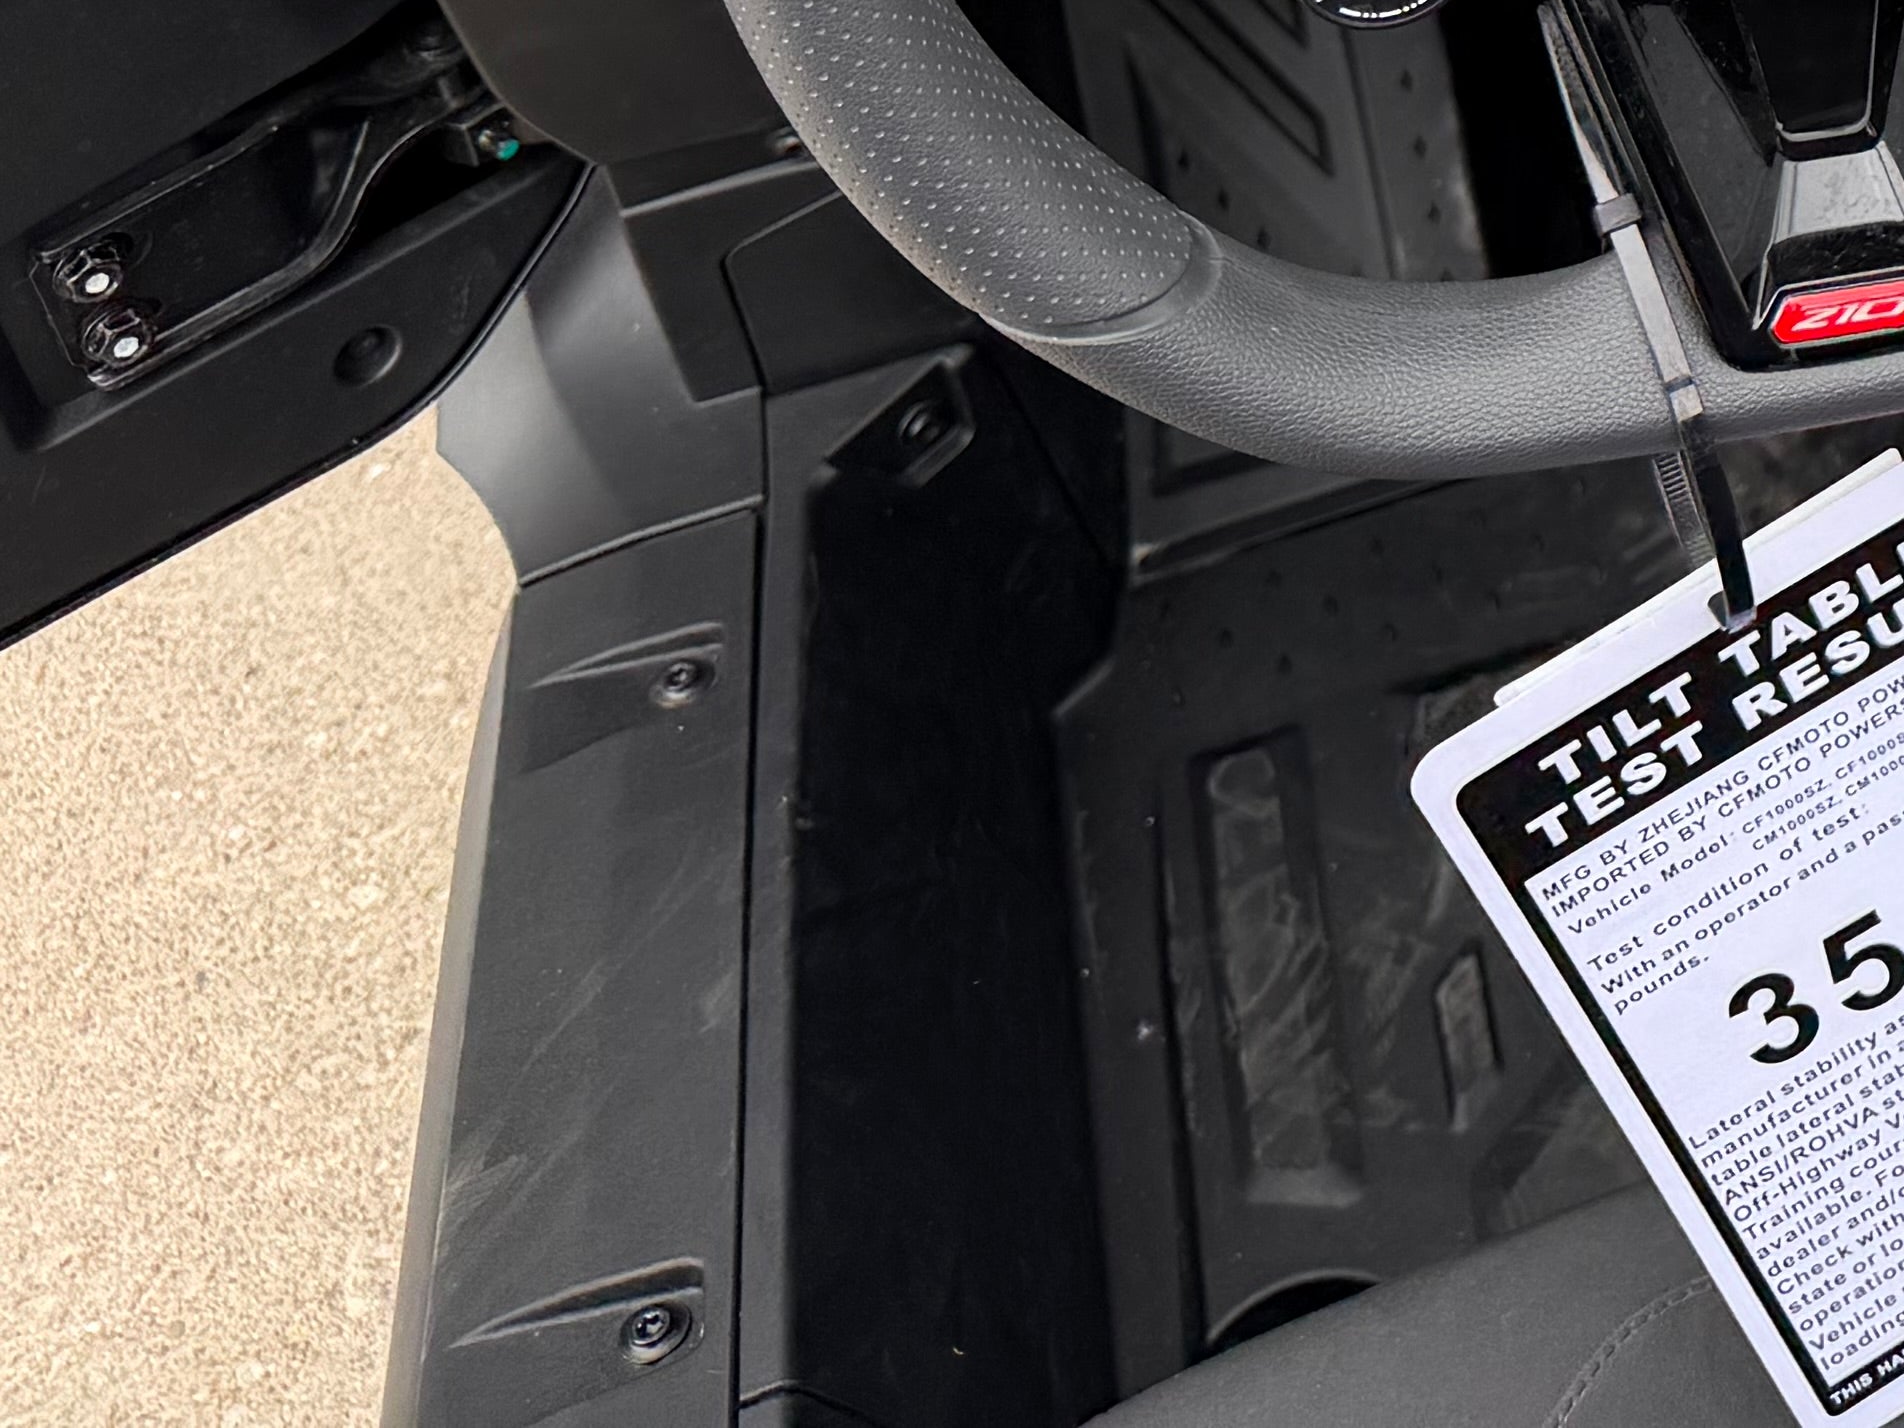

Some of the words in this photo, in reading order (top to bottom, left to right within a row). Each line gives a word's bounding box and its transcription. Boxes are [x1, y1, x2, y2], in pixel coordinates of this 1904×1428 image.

[1537, 671, 1691, 783] TILT
[1524, 720, 1702, 846] TEST
[1541, 863, 1591, 901] MFG
[1598, 838, 1627, 866] BY
[1636, 769, 1750, 844] ZHEJIANG
[1756, 710, 1849, 771] CFMOTO
[1550, 840, 1670, 918] IMPORTED
[1676, 814, 1706, 843] BY
[1717, 755, 1811, 818] CFMOTO
[1566, 882, 1652, 934] Vehicle
[1585, 935, 1644, 972] Test
[1651, 861, 1769, 936] condition
[1778, 835, 1802, 861] of
[1599, 958, 1657, 994] With
[1660, 938, 1690, 961] an
[1693, 875, 1791, 941] operator
[1796, 846, 1839, 881] and
[1843, 840, 1857, 854] a
[1613, 955, 1709, 1016] pounds.
[1687, 1089, 1776, 1150] Lateral
[1779, 1030, 1877, 1096] stability
[1700, 1063, 1862, 1169] manufacturer
[1866, 1049, 1892, 1070] in
[1710, 1144, 1773, 1186] table
[1775, 1092, 1855, 1148] lateral
[1724, 1105, 1879, 1206] ANSI/ROHVA
[1732, 1127, 1880, 1222] Off-Highway
[1741, 1175, 1845, 1240] Training
[1755, 1189, 1872, 1260] available.
[1766, 1224, 1839, 1277] dealer
[1776, 1244, 1853, 1295] Check
[1787, 1272, 1847, 1314] state
[1851, 1252, 1875, 1274] or
[1807, 1293, 1897, 1351] Vehicle
[1828, 1371, 1873, 1404] THIS
